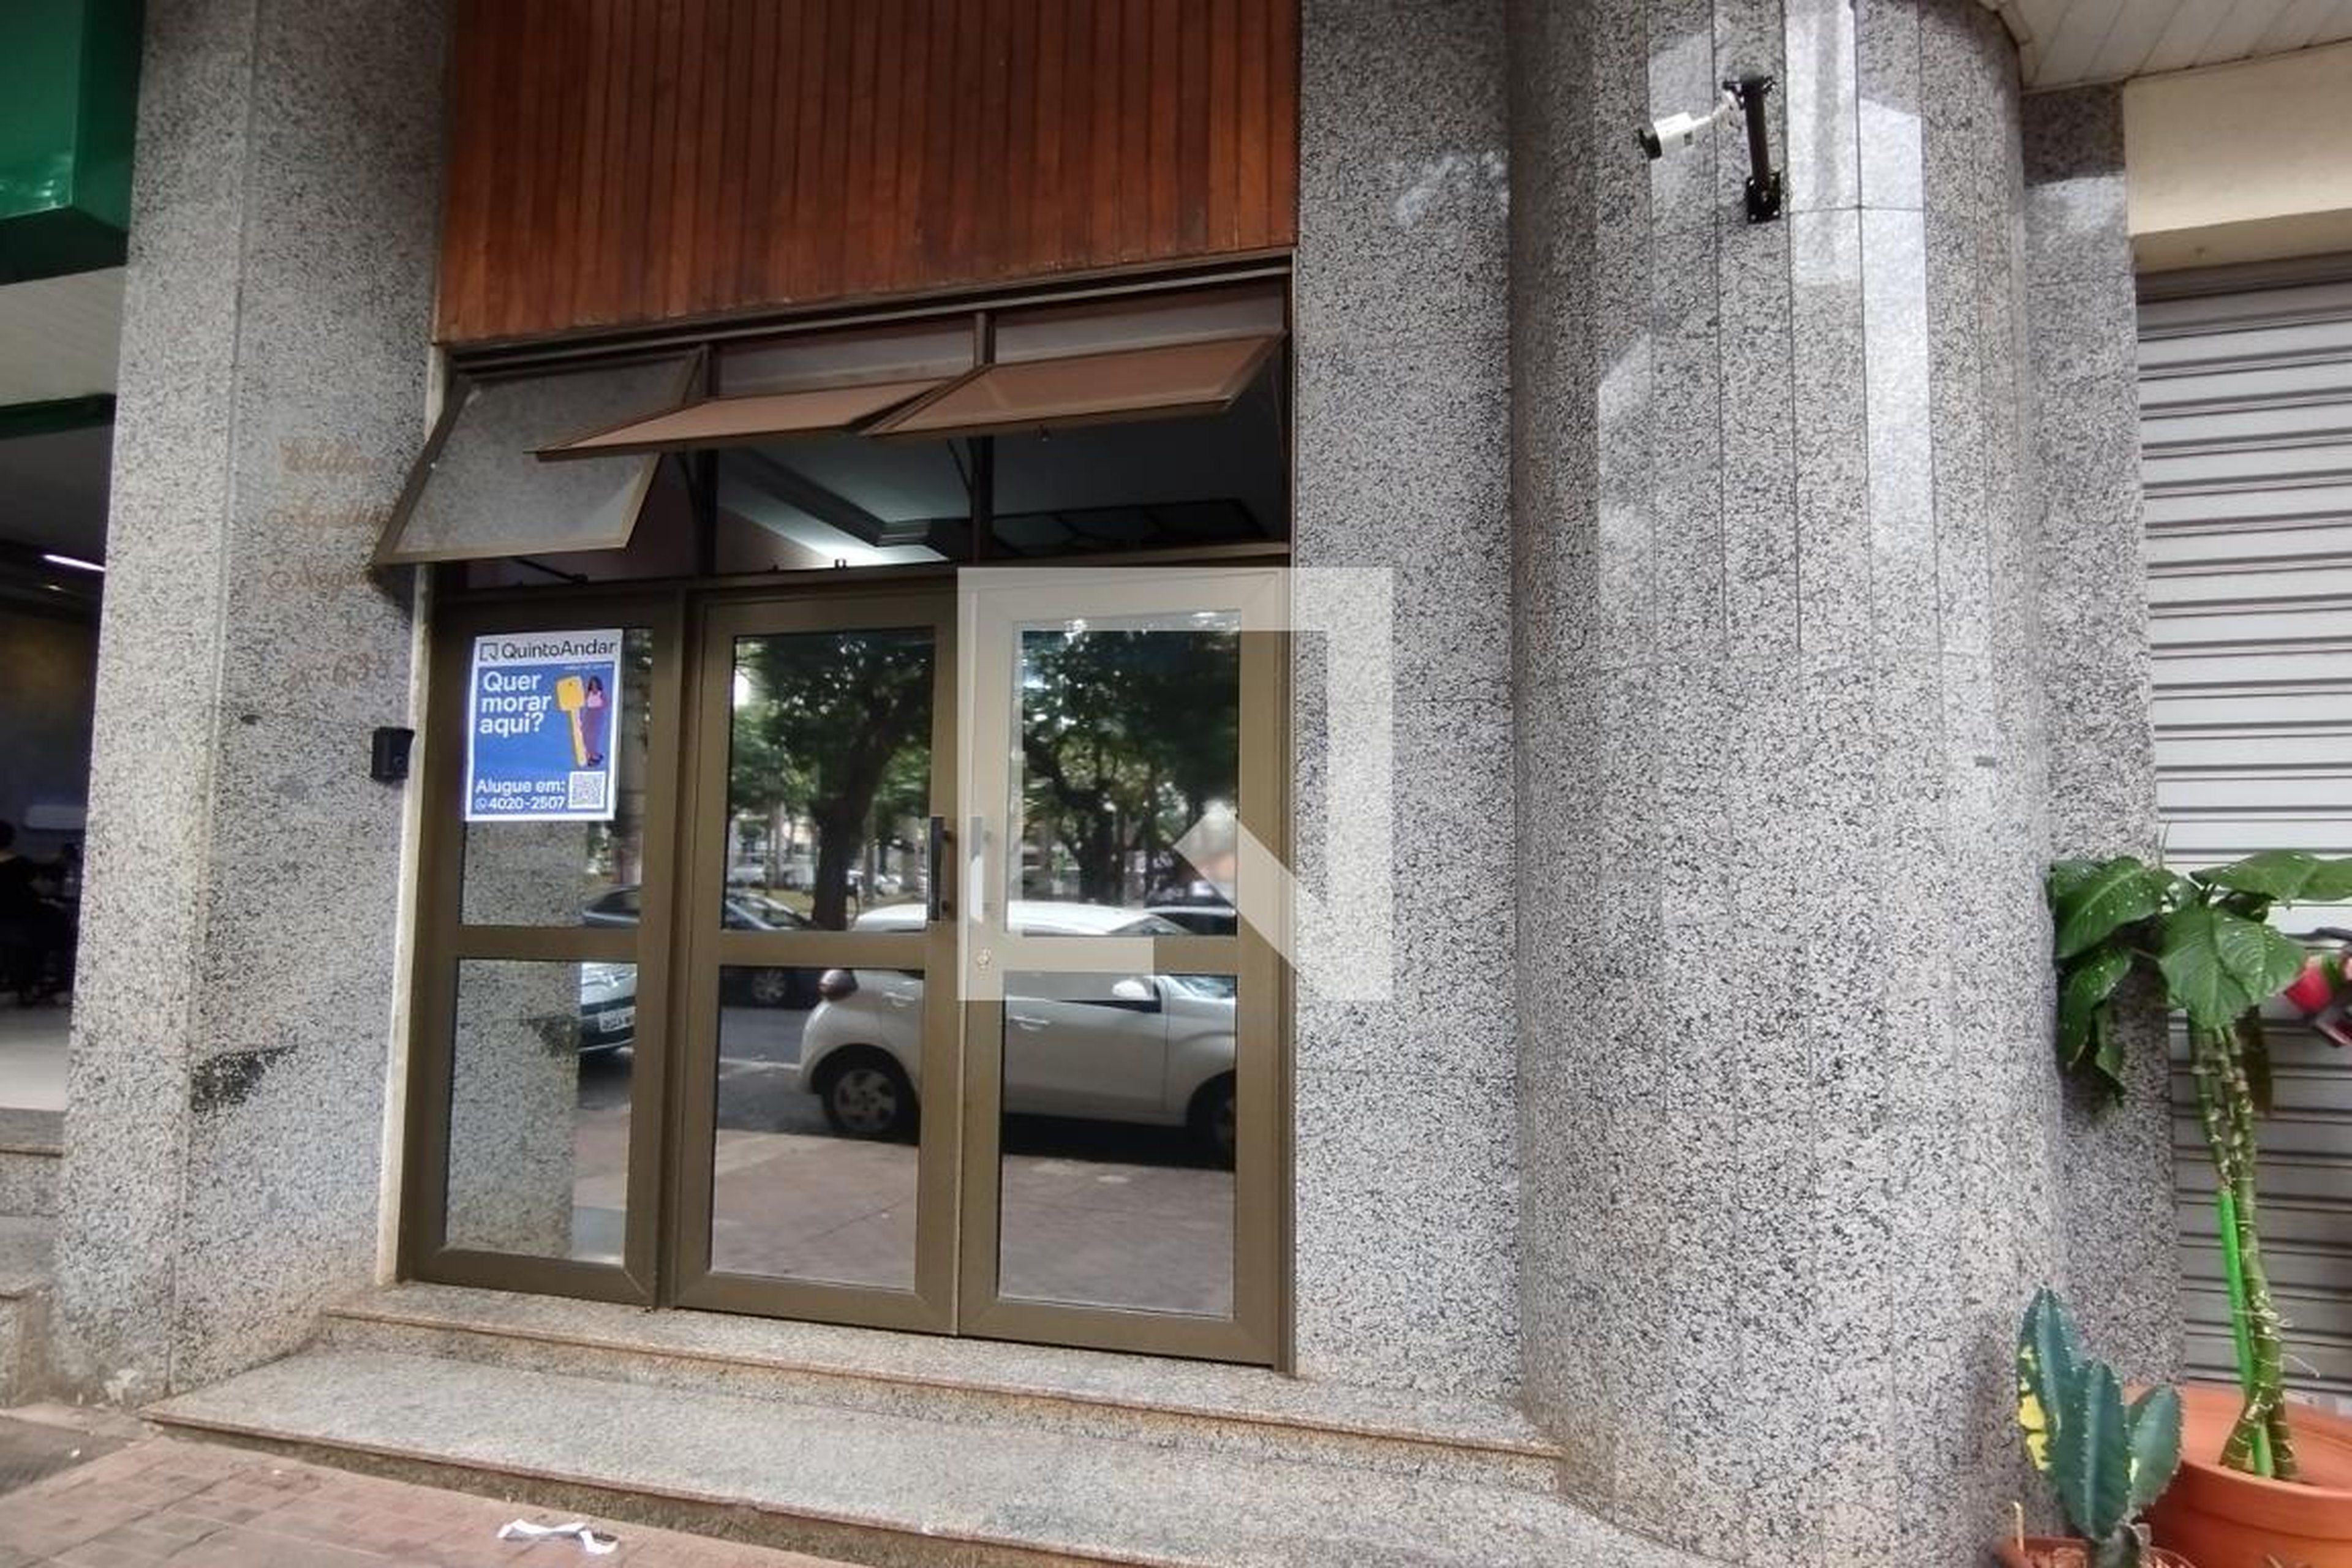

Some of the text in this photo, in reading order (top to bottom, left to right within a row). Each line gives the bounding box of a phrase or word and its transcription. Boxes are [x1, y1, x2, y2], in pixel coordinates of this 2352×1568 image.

[501, 639, 616, 659] QuintoAndar
[483, 671, 541, 692] Quer
[481, 695, 551, 713] morar
[479, 712, 544, 738] aqui?
[475, 778, 566, 796] Alugue em:
[489, 796, 565, 810] 4020-2507
